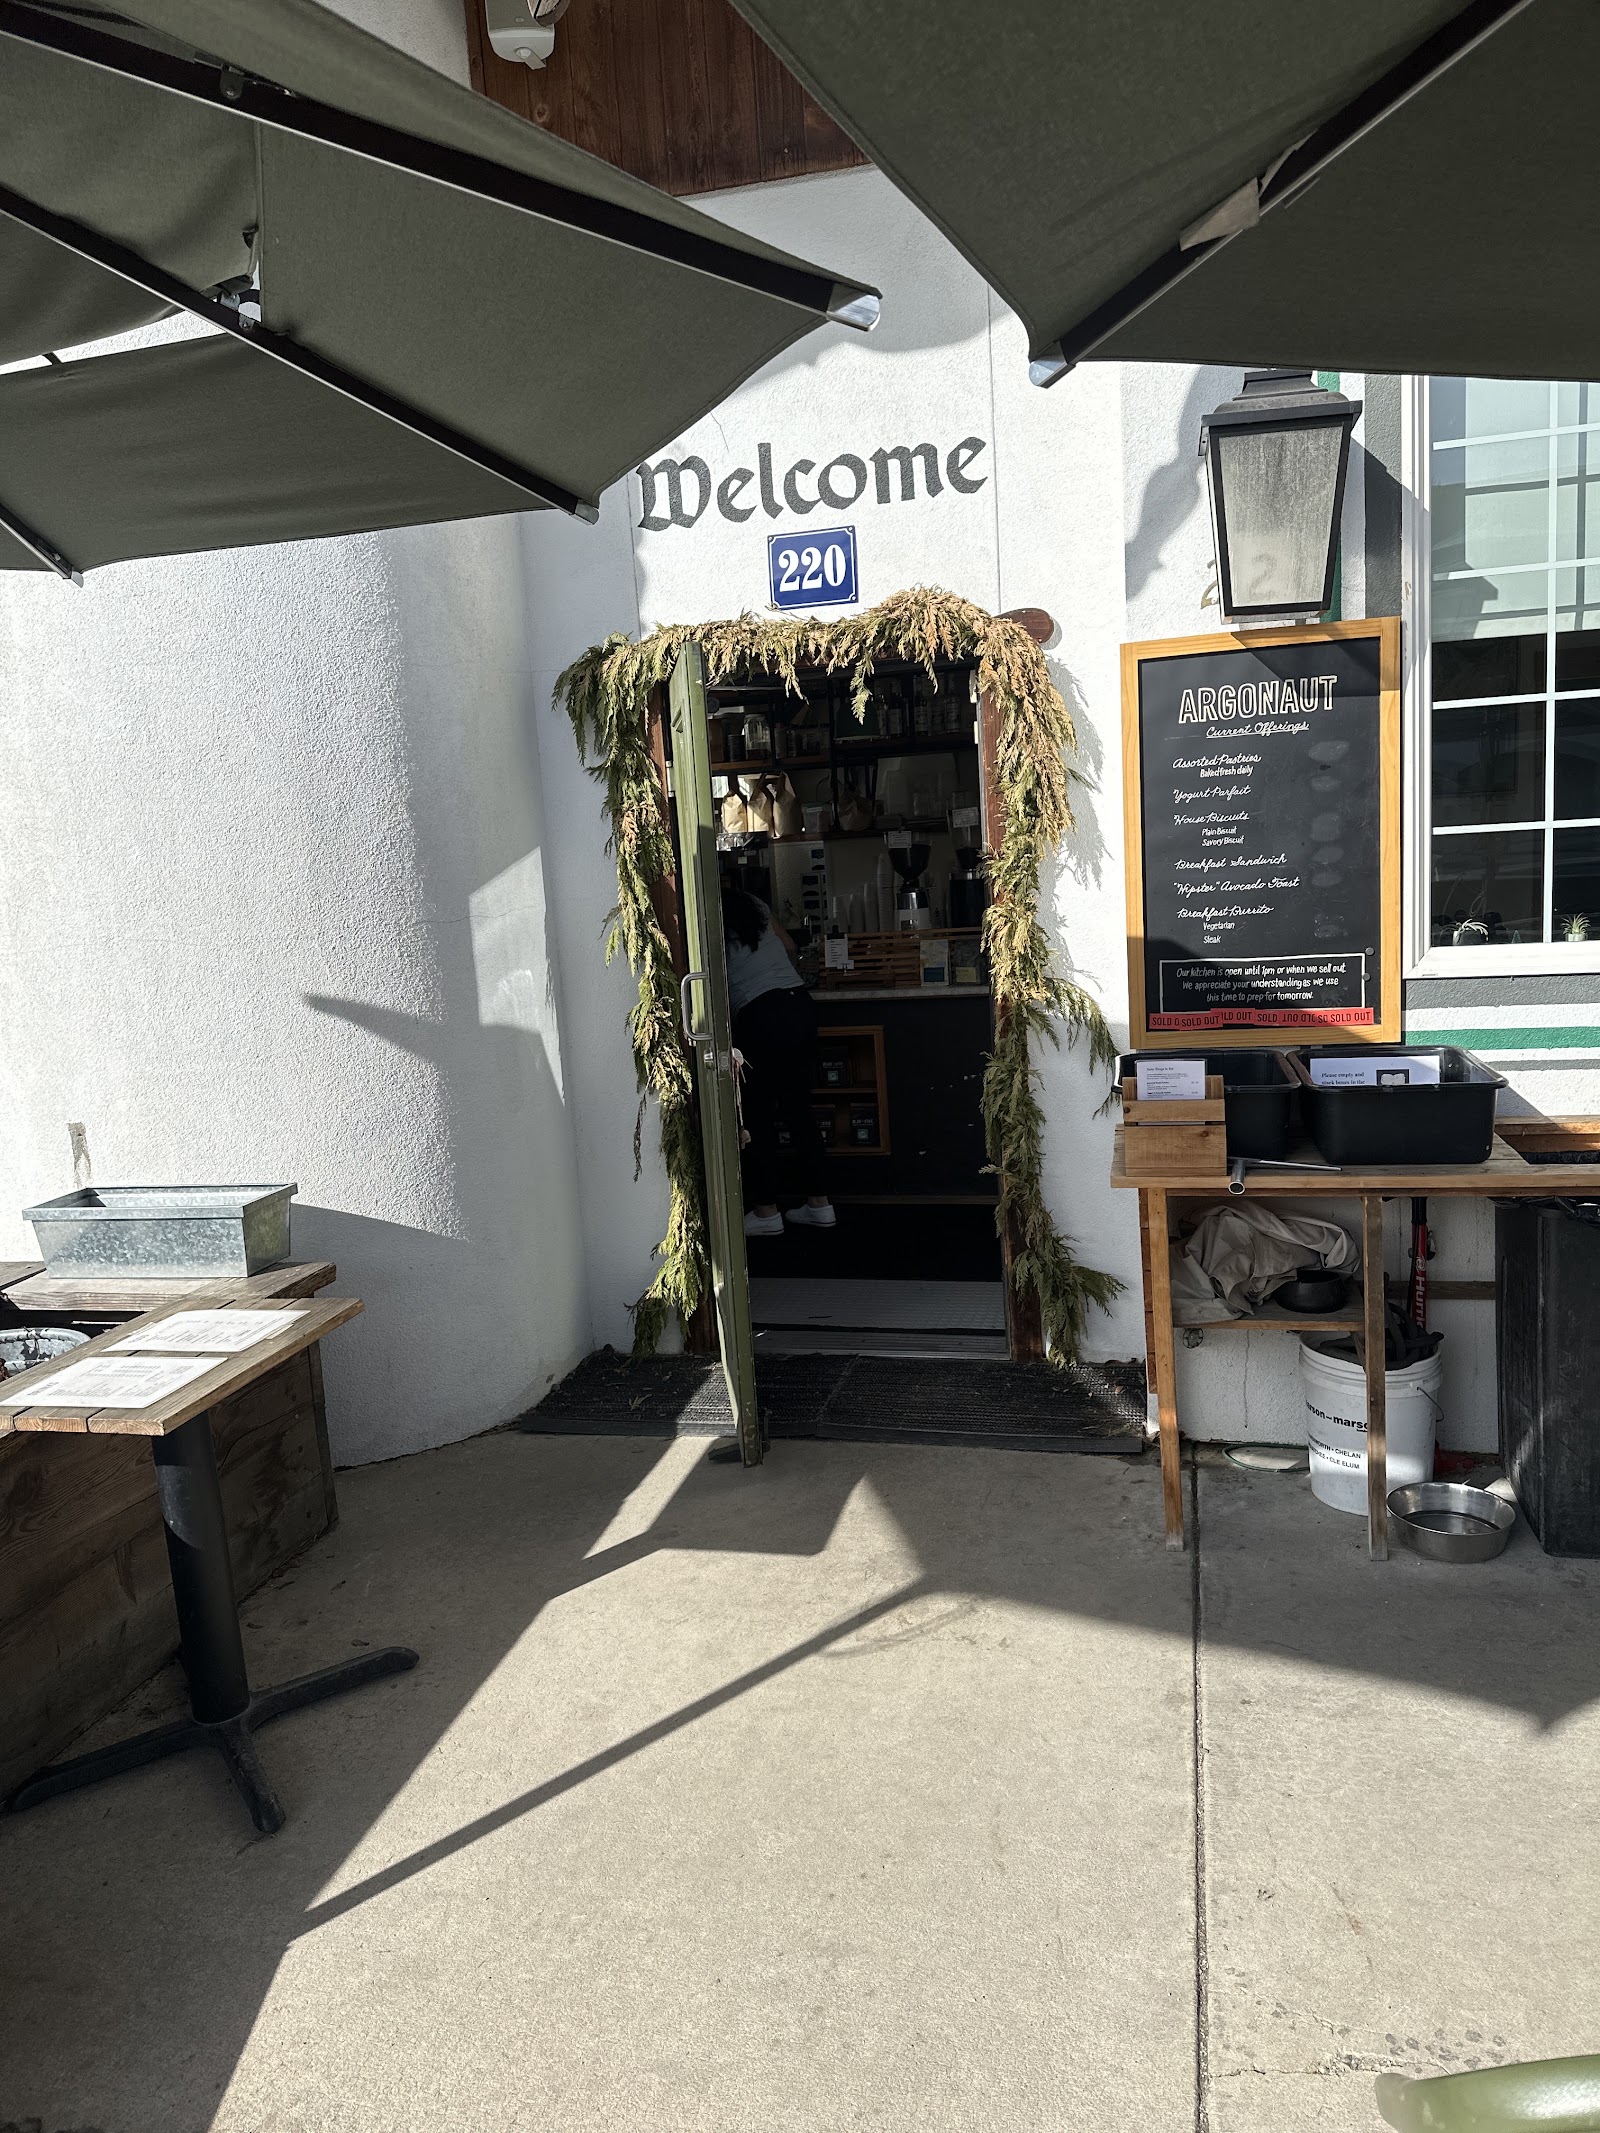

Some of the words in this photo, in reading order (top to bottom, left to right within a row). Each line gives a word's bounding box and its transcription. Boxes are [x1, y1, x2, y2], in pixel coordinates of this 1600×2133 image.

[637, 436, 988, 532] Welcome
[778, 544, 847, 592] 220
[1178, 675, 1338, 724] ARGONAUT
[1206, 724, 1251, 738] Current
[1254, 720, 1310, 737] Offerings
[1173, 755, 1218, 768] Assorted
[1217, 753, 1261, 765] Pastries
[1200, 767, 1219, 778] Baked
[1219, 766, 1236, 777] fresh
[1237, 765, 1254, 776] daily
[1173, 787, 1210, 803] Yogurt
[1210, 785, 1251, 801] Parfait
[1173, 814, 1206, 826] House
[1201, 827, 1216, 836] Plain
[1217, 825, 1237, 836] Biscuit
[1202, 838, 1224, 847] Savory
[1223, 835, 1244, 845] Biscuit
[1174, 857, 1227, 873] Breakfast
[1229, 853, 1287, 867] Sandwich
[1220, 878, 1266, 891] Avocado
[1267, 876, 1300, 889] Toast
[1176, 906, 1230, 921] Breakfast
[1228, 904, 1274, 917] Burrito
[1203, 921, 1235, 931] Vegetarian
[1203, 935, 1222, 944] Steak
[1176, 967, 1189, 978] Our
[1189, 966, 1216, 978] kitchen
[1217, 966, 1223, 977] is
[1224, 968, 1243, 978] open
[1244, 964, 1261, 975] until
[1261, 965, 1275, 978] 1pm
[1286, 965, 1305, 975] when
[1306, 965, 1318, 973] we
[1318, 963, 1332, 973] sell
[1182, 980, 1193, 990] We
[1194, 980, 1231, 992] appreciate
[1232, 980, 1250, 991] your
[1250, 977, 1302, 989] understanding
[1302, 979, 1311, 987] as
[1312, 978, 1324, 986] we
[1325, 977, 1339, 986] use
[1206, 992, 1219, 1002] this
[1221, 992, 1237, 1002] time
[1238, 991, 1245, 1001] to
[1246, 993, 1264, 1003] prep
[1265, 991, 1275, 1001] for
[1152, 1017, 1172, 1026] SOLD
[1181, 1018, 1201, 1027] SOLD
[1204, 1015, 1220, 1025] OUT
[1236, 1011, 1252, 1020] OUT
[1257, 1013, 1278, 1022] SOLD
[1330, 1013, 1351, 1023] SOLD
[1354, 1011, 1370, 1021] OUT
[1335, 1448, 1361, 1459] CHELAN
[1341, 1461, 1360, 1469] ELUM
